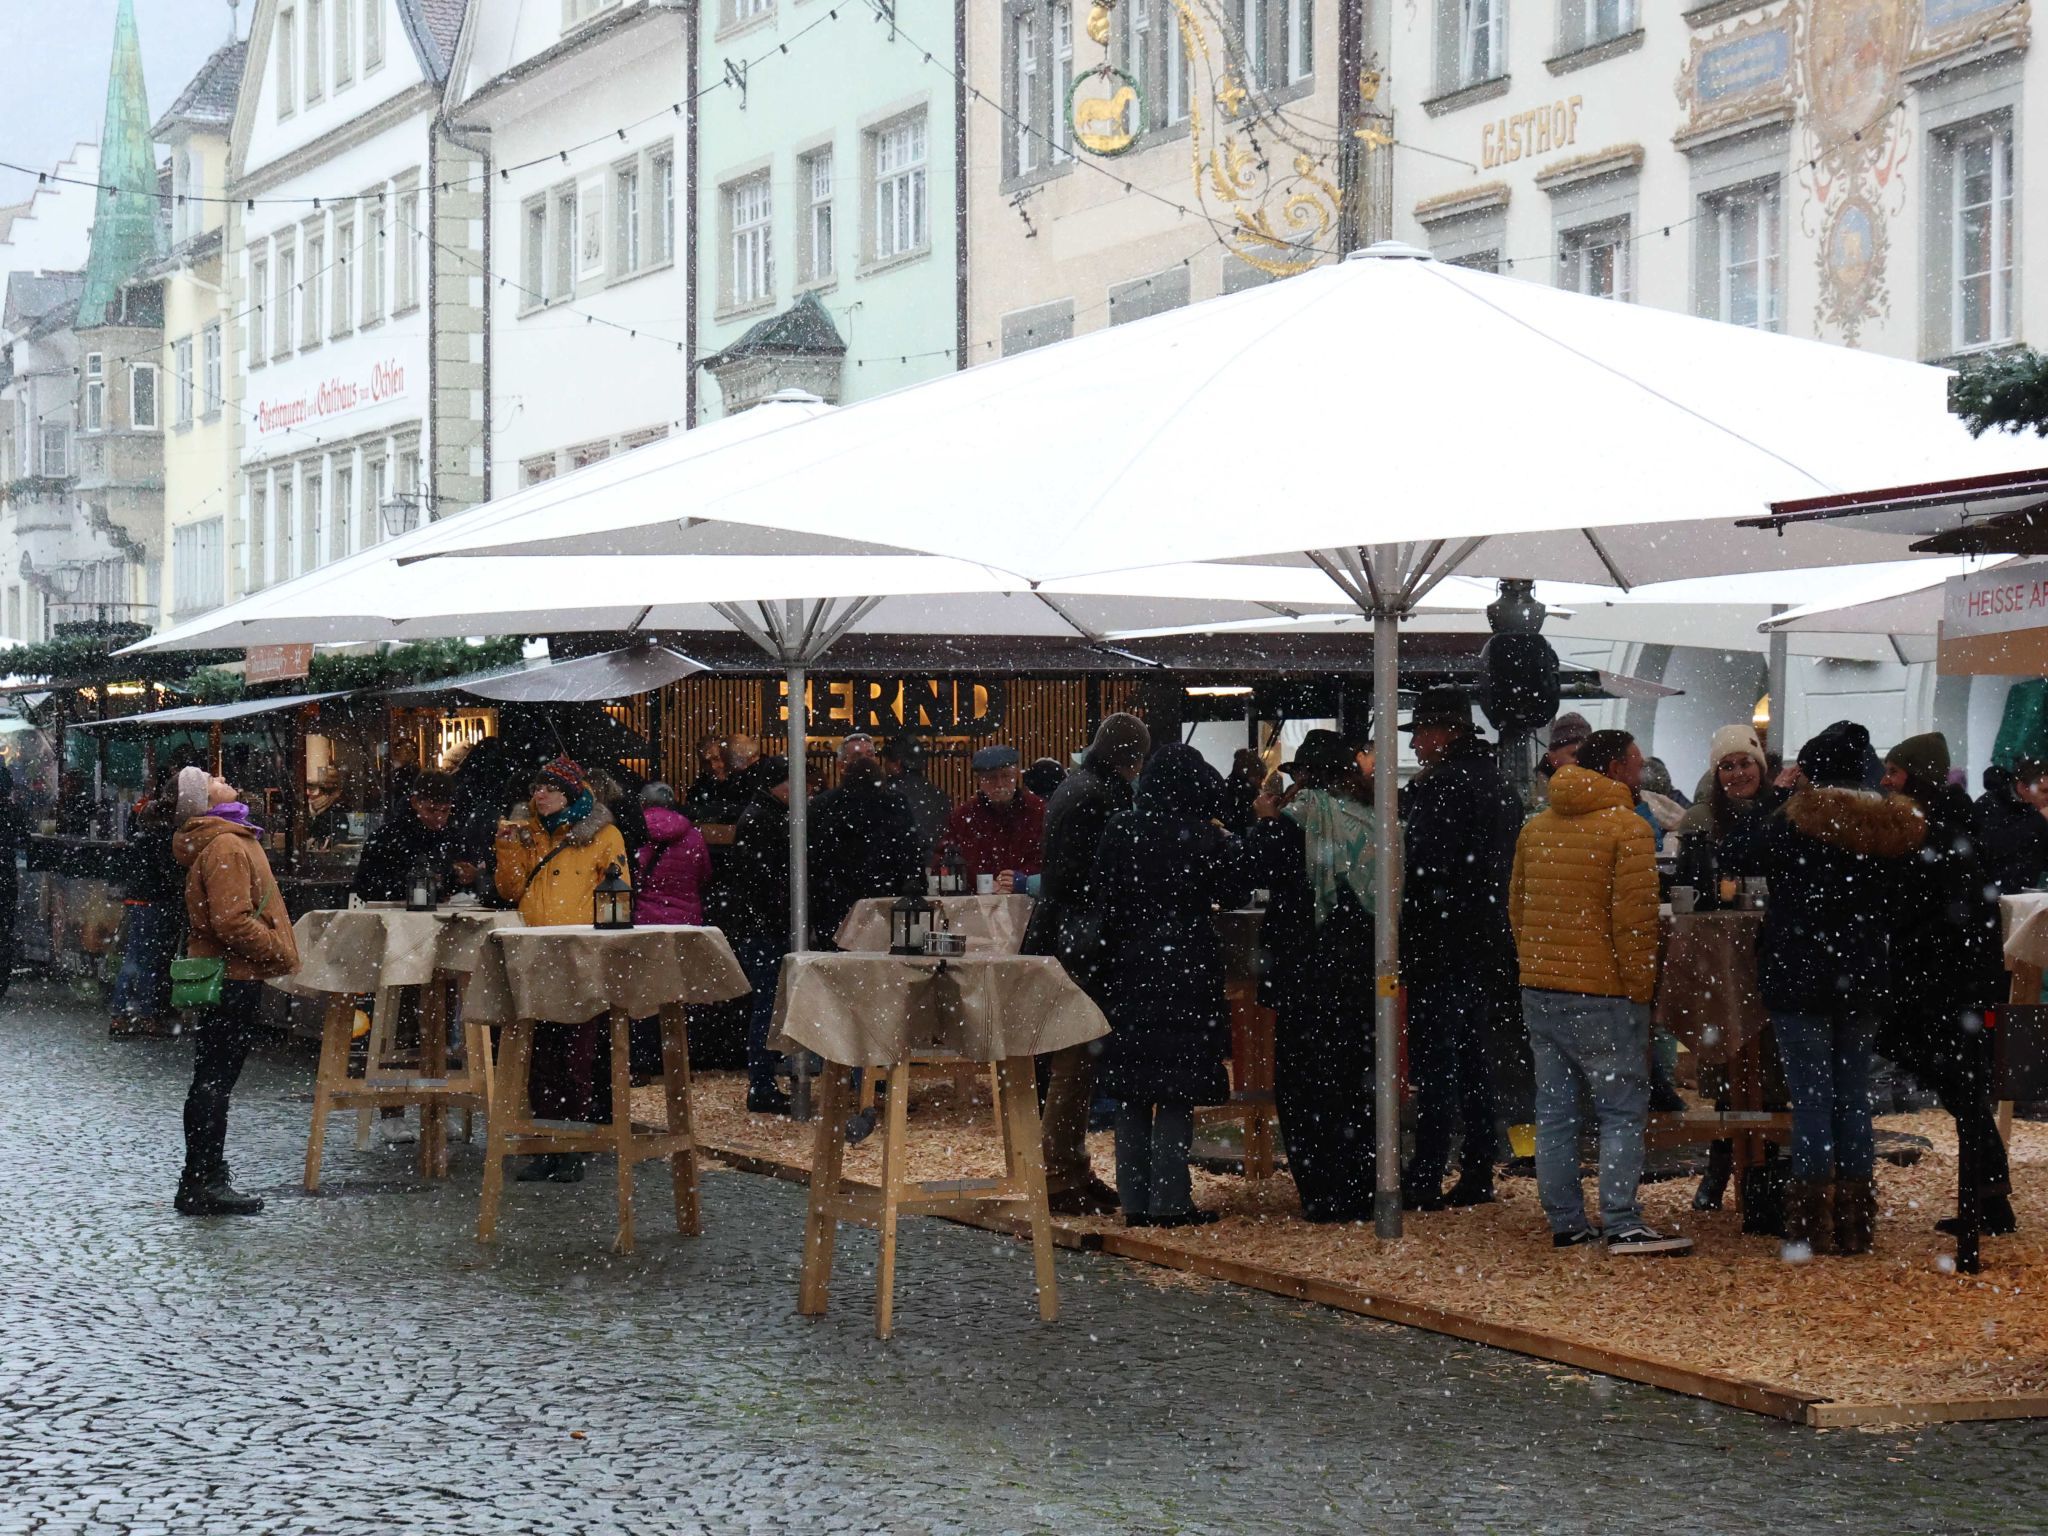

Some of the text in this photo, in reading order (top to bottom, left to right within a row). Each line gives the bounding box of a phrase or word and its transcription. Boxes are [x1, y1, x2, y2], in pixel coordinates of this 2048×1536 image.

[1482, 95, 1583, 170] GASTHOF
[1968, 584, 2024, 618] HEISSE
[764, 679, 1003, 726] BERND
